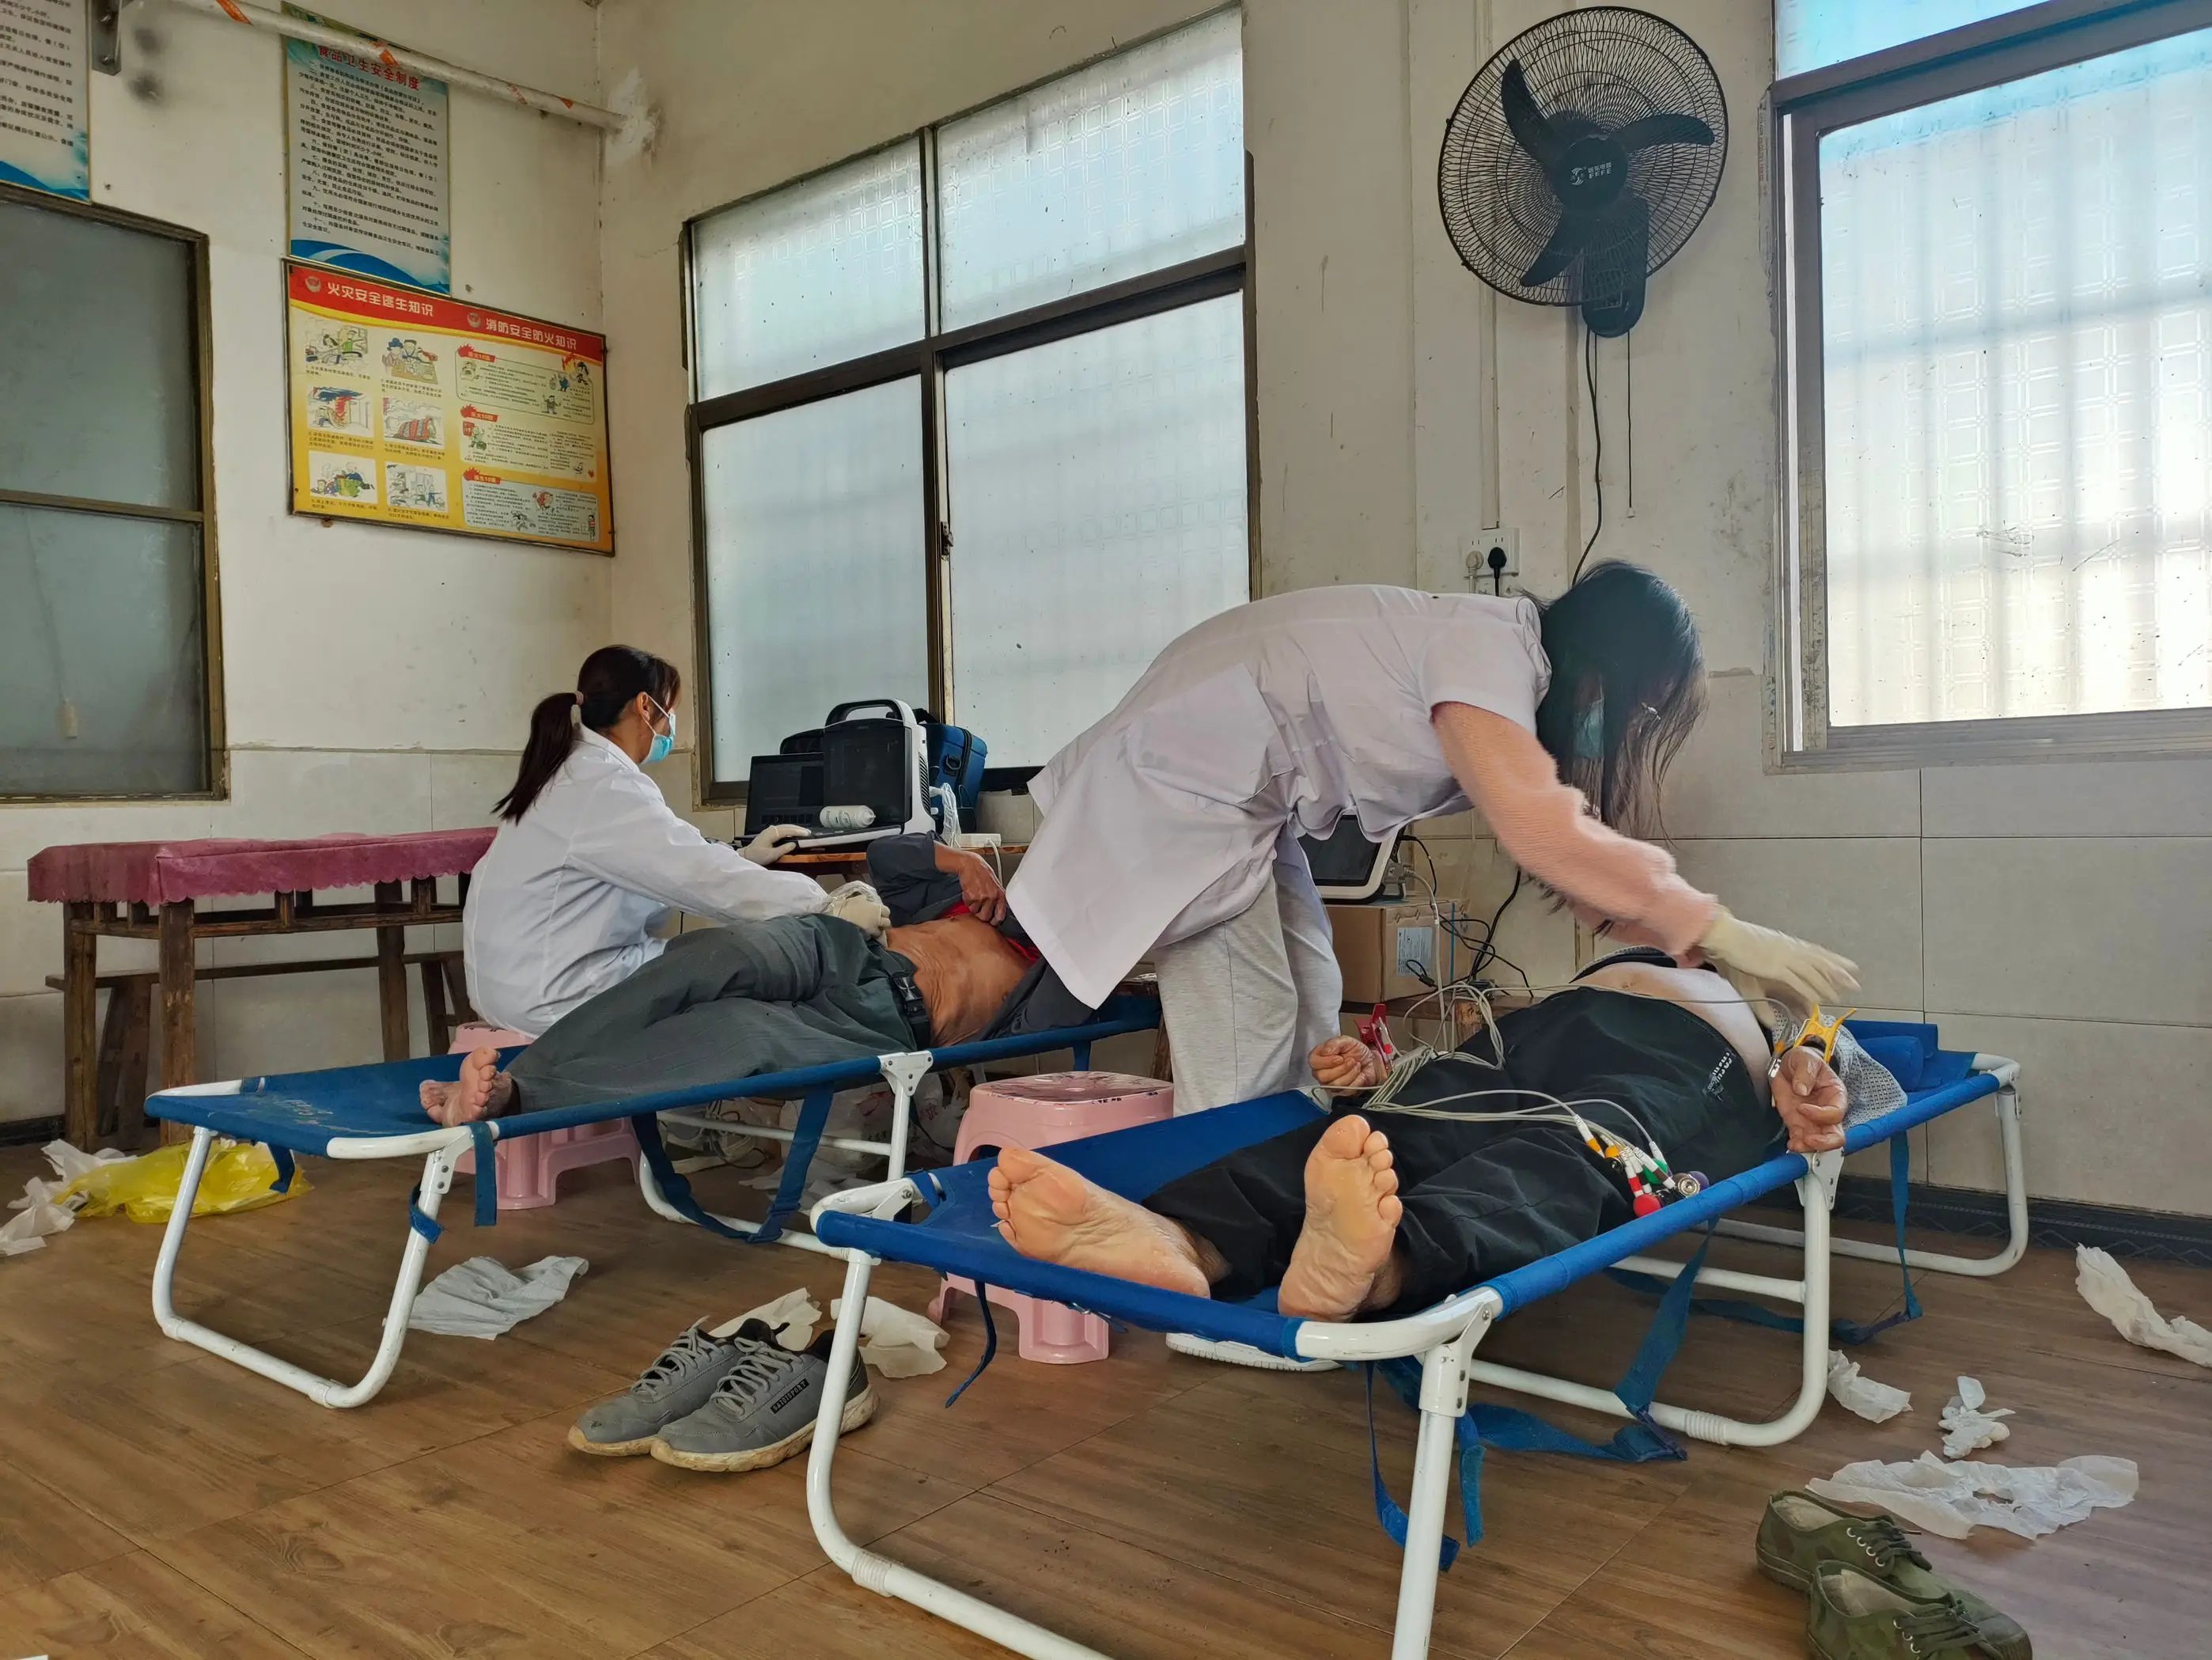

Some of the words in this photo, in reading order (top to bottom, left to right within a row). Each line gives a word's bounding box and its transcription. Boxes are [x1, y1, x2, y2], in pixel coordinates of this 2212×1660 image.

[327, 282, 434, 316] 火灾安全逃生知识
[486, 318, 577, 350] 消防安全防火知识
